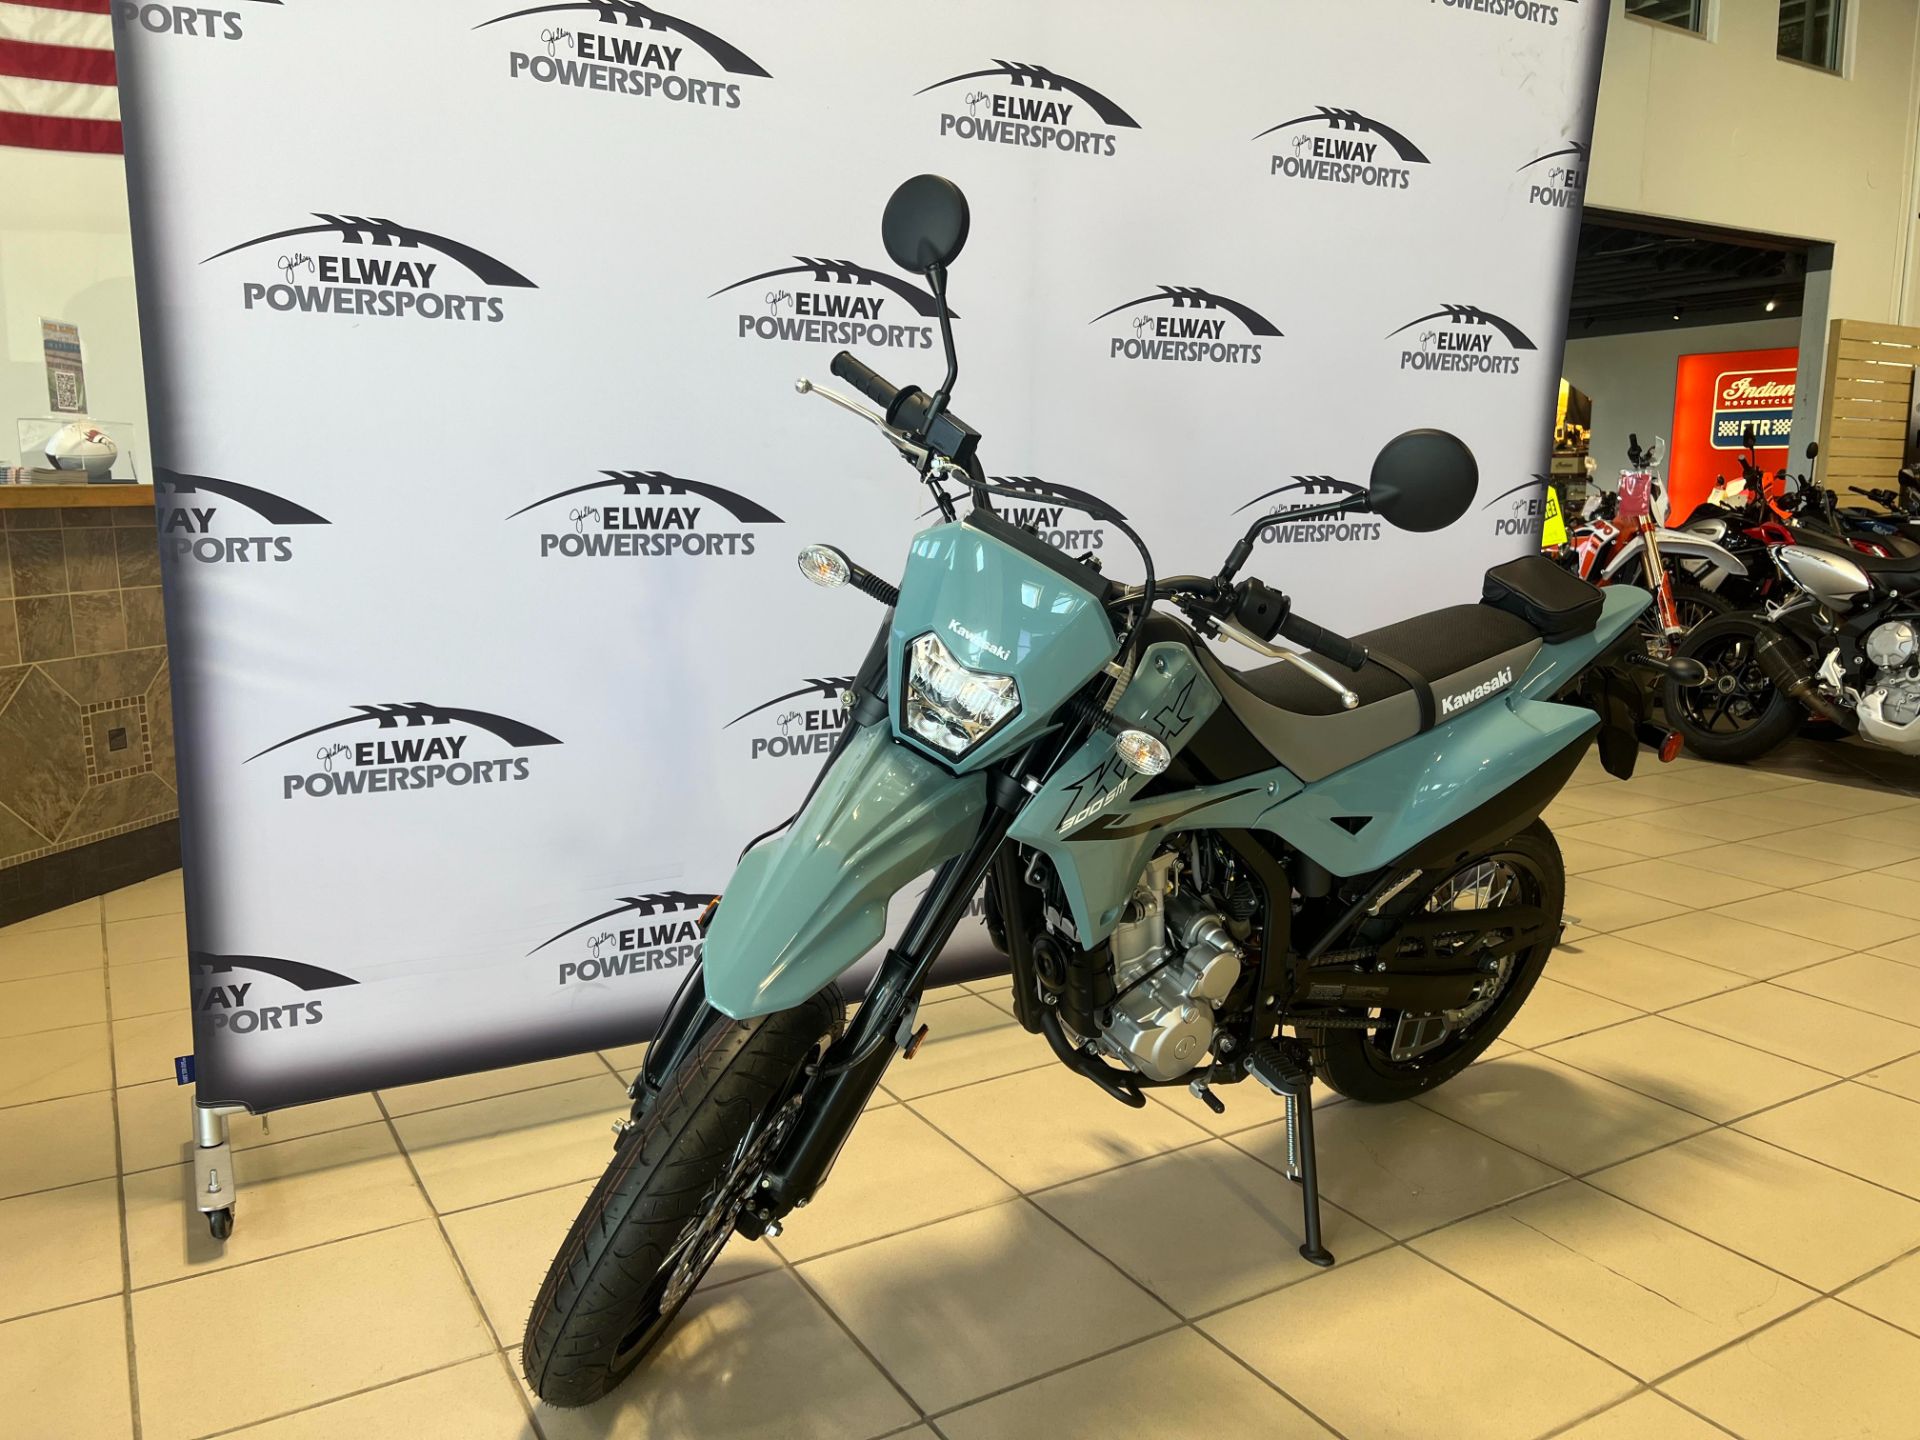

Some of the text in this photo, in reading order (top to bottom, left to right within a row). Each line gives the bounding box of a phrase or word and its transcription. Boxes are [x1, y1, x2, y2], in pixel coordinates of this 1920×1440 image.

[1431, 0, 1559, 26] WERSPORTS
[577, 31, 683, 72] ELWAY
[510, 51, 741, 109] POWERSPORTS
[992, 94, 1073, 125] ELWAY
[940, 113, 1116, 156] POWERSPORTS
[1313, 137, 1377, 163] ELWAY
[1271, 155, 1410, 189] POWERSPORTS
[318, 255, 437, 289] ELWAY
[243, 282, 504, 323] POWERSPORTS
[796, 292, 884, 320] ELWAY
[739, 315, 933, 349] POWERSPORTS
[1156, 317, 1225, 339] ELWAY
[1437, 332, 1493, 352] ELWAY
[1111, 338, 1261, 364] POWERSPORTS
[1401, 351, 1520, 374] POWERSPORTS
[1723, 377, 1796, 400] Indian
[1724, 398, 1793, 406] MOTORCYCLE
[603, 507, 701, 530] ELWAY
[992, 508, 1064, 529] LWAY
[1257, 522, 1381, 544] OWERSPORTS
[541, 533, 755, 557] POWERSPORTS
[948, 619, 1011, 661] Kawasaki
[1442, 666, 1512, 715] Kawasaki
[355, 735, 467, 766] ELWAY
[284, 757, 529, 799] POWERSPORTS
[1059, 777, 1129, 834] 300SM
